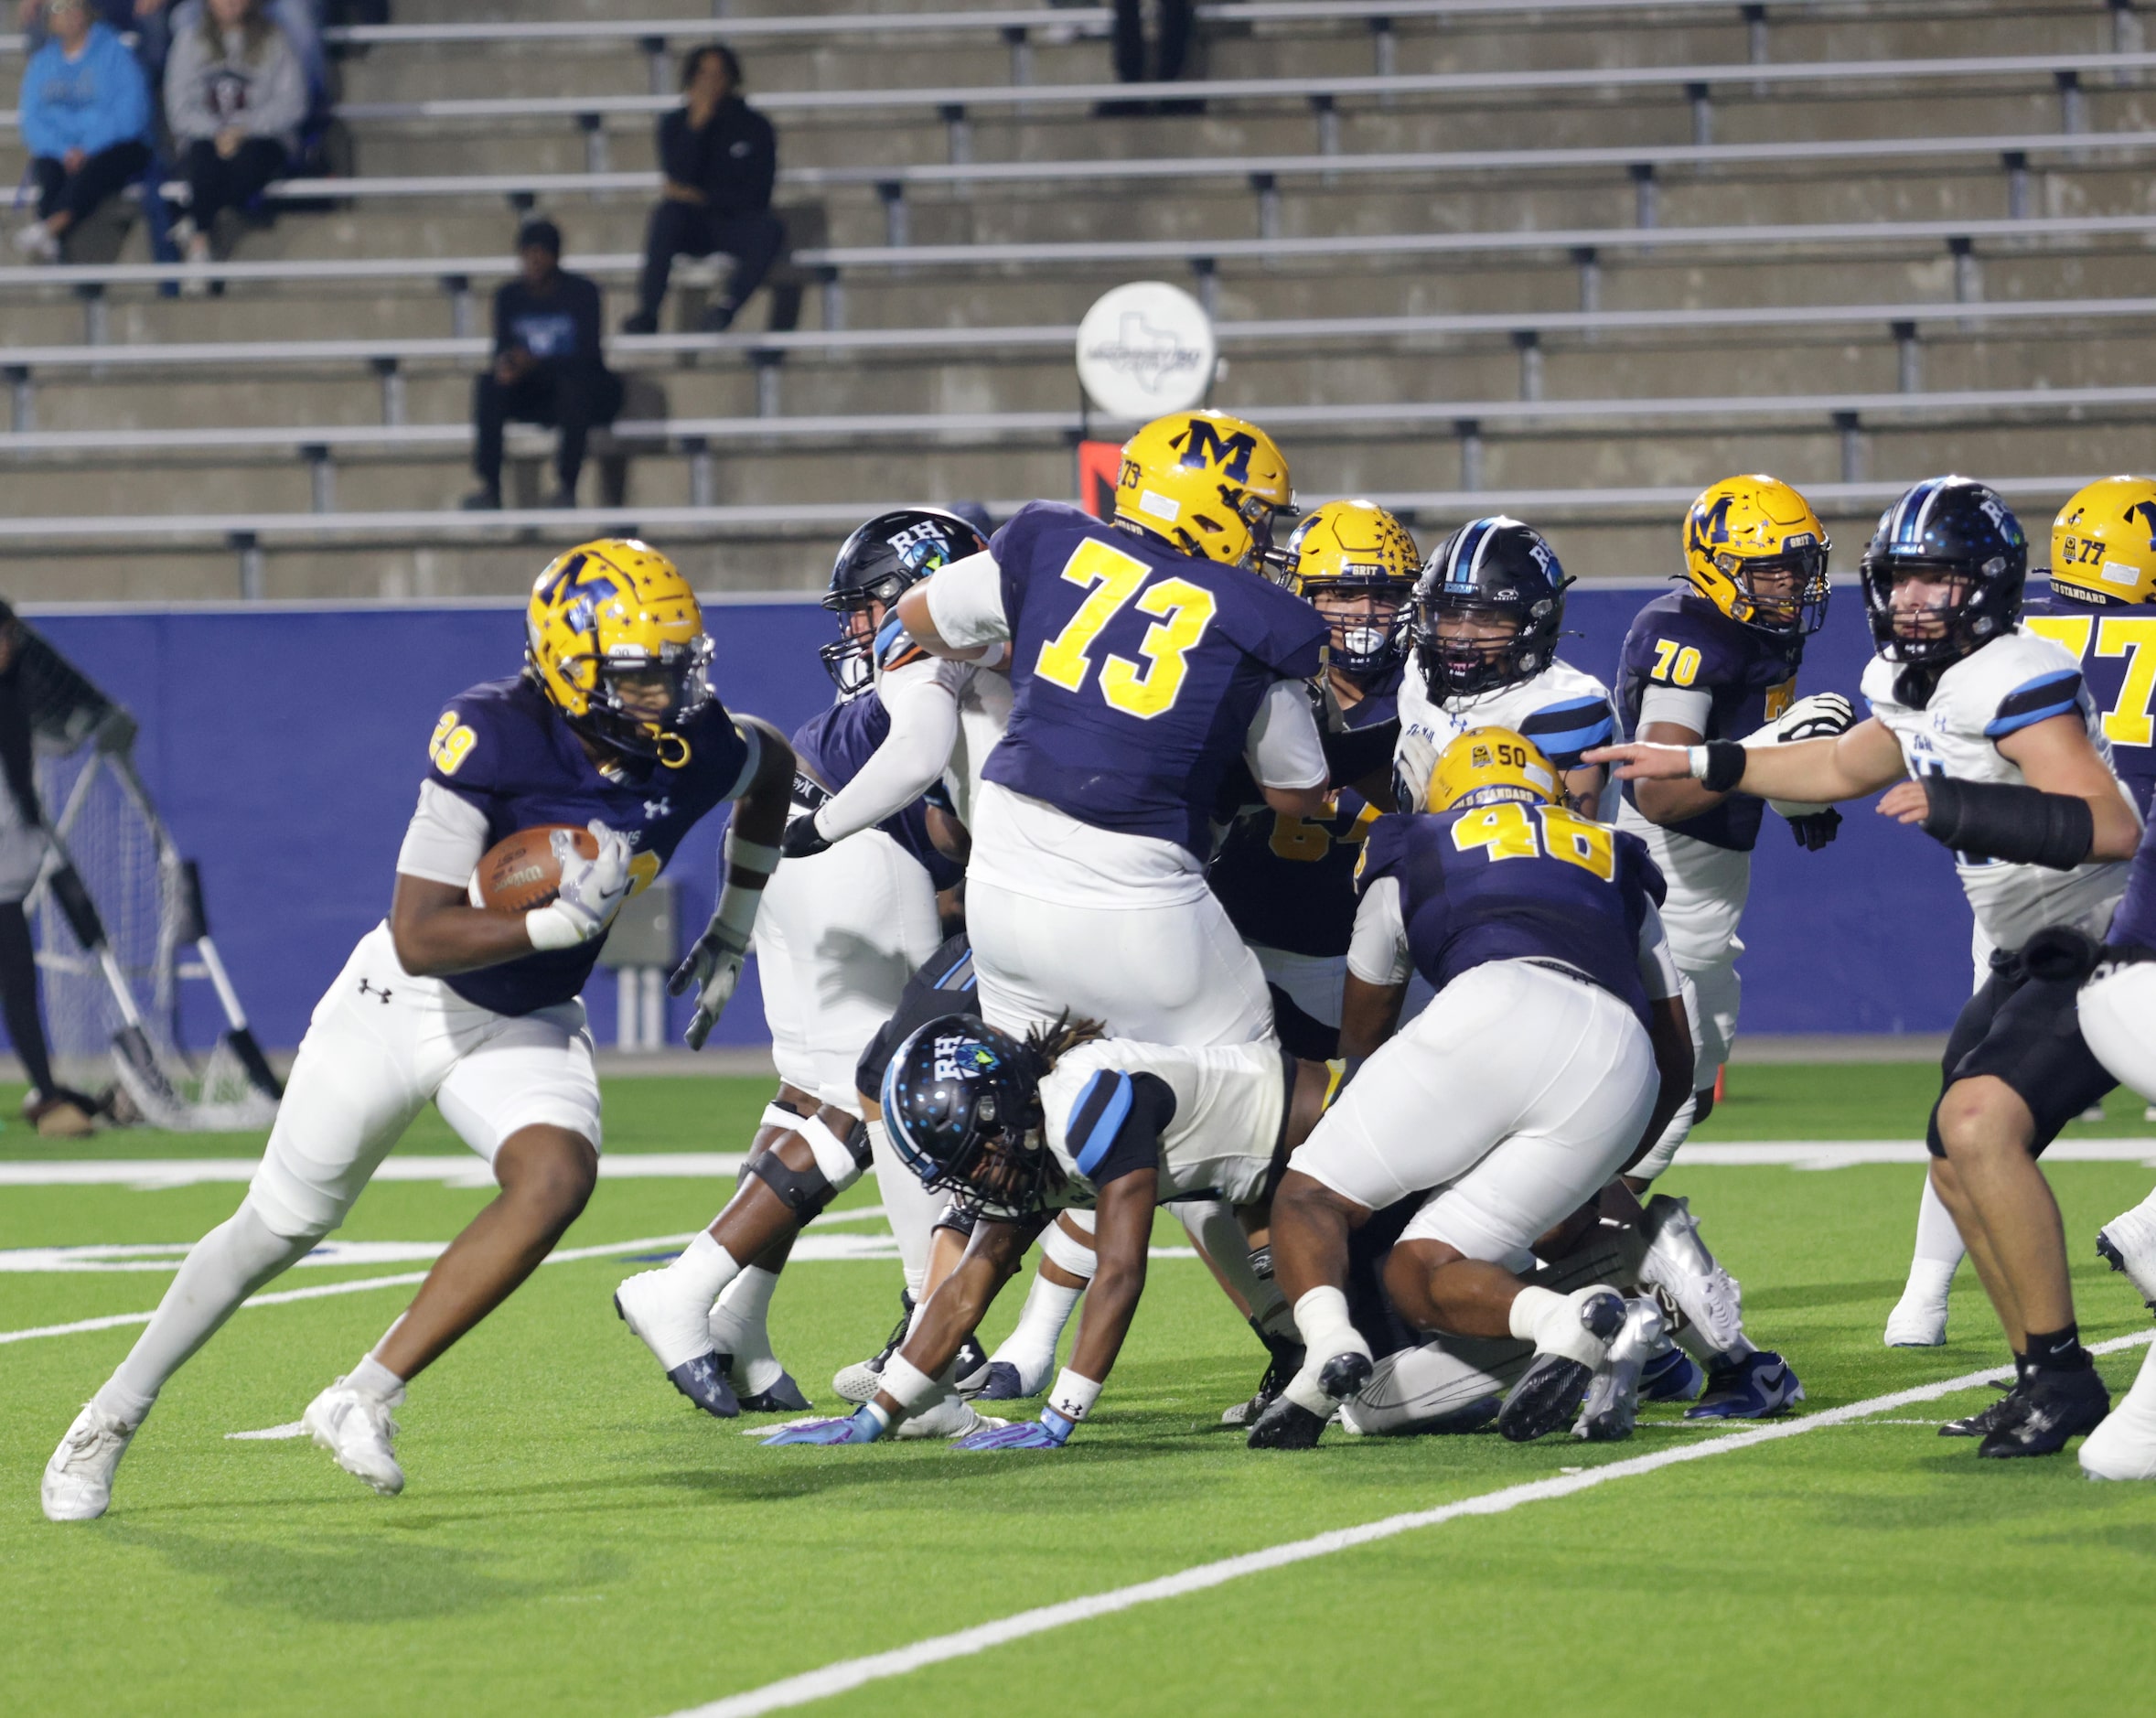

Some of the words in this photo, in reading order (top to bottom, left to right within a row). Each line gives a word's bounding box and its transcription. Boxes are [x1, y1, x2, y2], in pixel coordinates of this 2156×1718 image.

[1180, 419, 1257, 484] M
[1121, 460, 1141, 489] 73
[887, 520, 944, 560] RH
[1690, 497, 1735, 544] M
[1790, 534, 1809, 547] GRIT
[1352, 565, 1378, 575] GRIT
[2078, 539, 2106, 565] 77
[2060, 584, 2107, 605] STANDARD
[1034, 537, 1217, 720] 73
[1650, 639, 1701, 687] 70
[2022, 615, 2156, 747] 77
[429, 710, 477, 777] 29
[1497, 744, 1527, 768] 50
[1475, 788, 1534, 803] STANDARD
[1451, 802, 1615, 883] 46
[934, 1035, 961, 1082] RH
